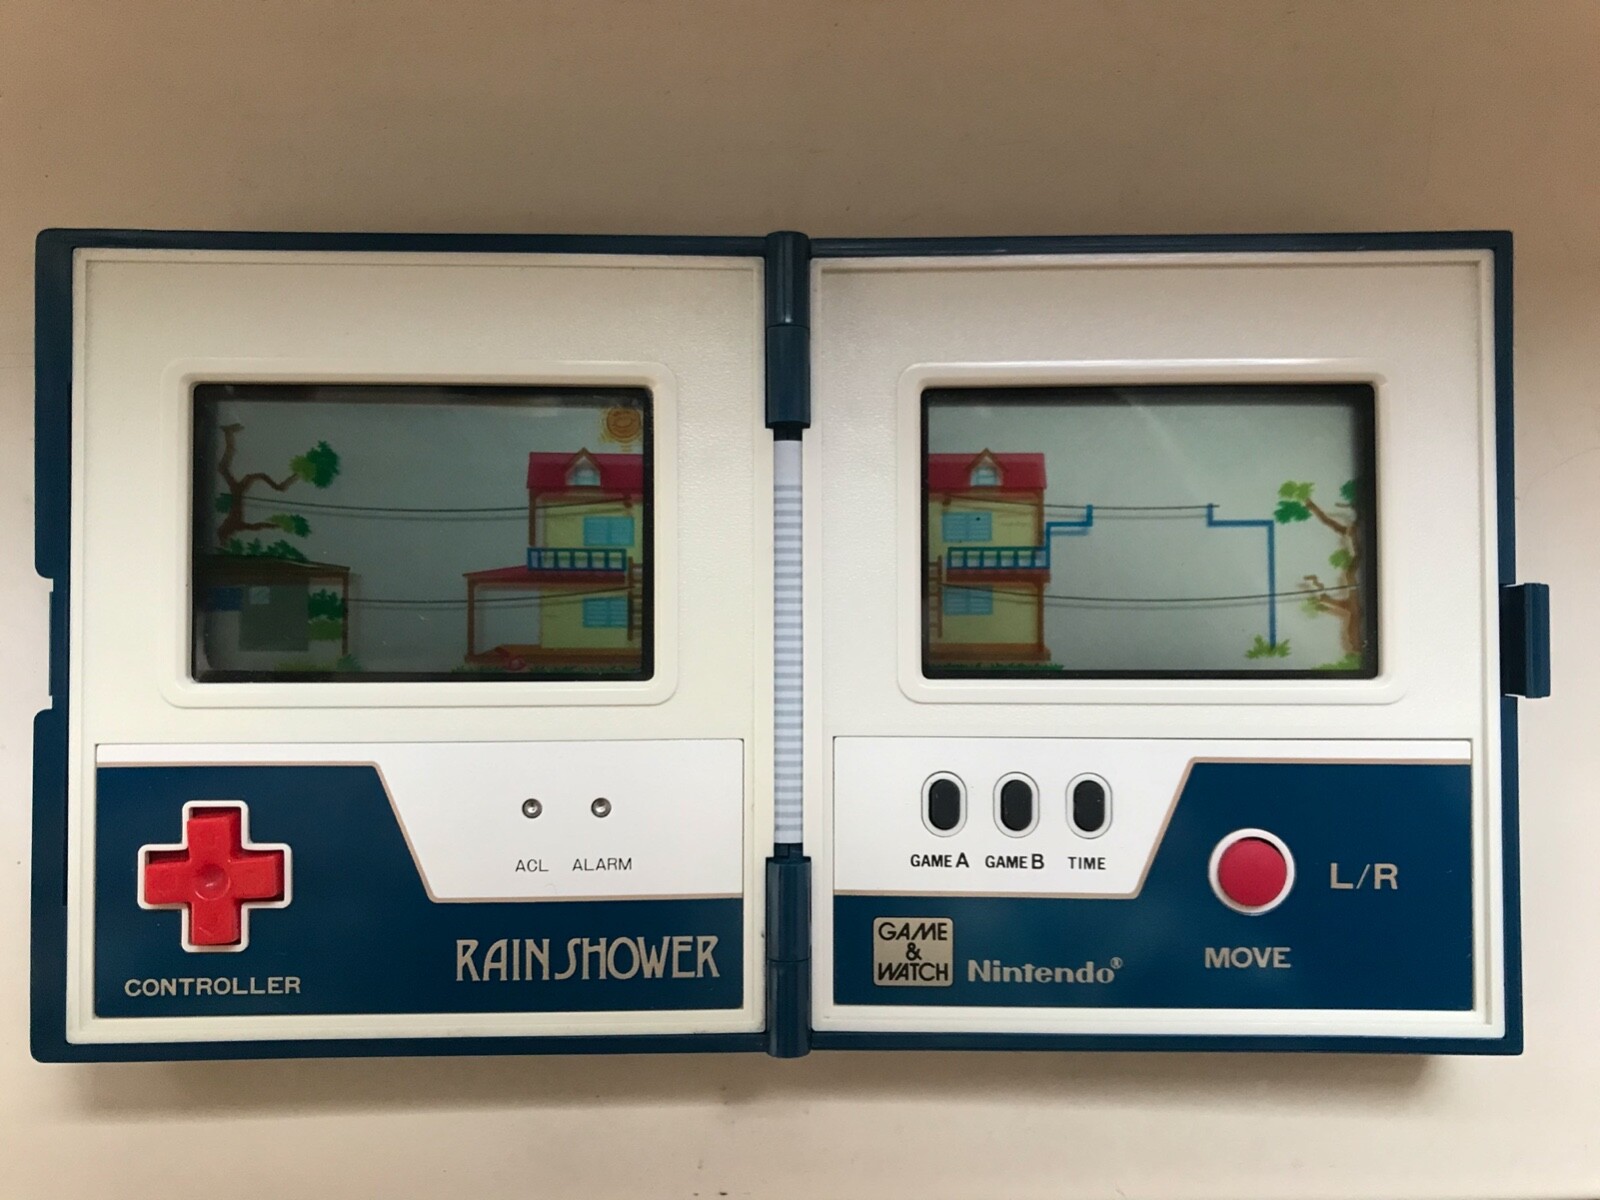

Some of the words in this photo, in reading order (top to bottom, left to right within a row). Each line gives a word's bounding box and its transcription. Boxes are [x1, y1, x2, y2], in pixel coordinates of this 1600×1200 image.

[514, 858, 549, 873] ACL
[572, 857, 633, 872] ALARM
[910, 853, 953, 869] GAME
[955, 852, 970, 868] A
[984, 855, 1028, 869] GAME
[1031, 852, 1045, 870] B
[1067, 856, 1107, 871] TIME
[1330, 862, 1399, 890] L/R
[877, 921, 949, 941] GAME
[456, 938, 550, 982] RAIN
[554, 935, 721, 980] SHOWER
[905, 941, 923, 961] &
[1205, 946, 1292, 969] MOVE
[877, 962, 949, 982] WATCH
[124, 976, 301, 997] CONTROLLER
